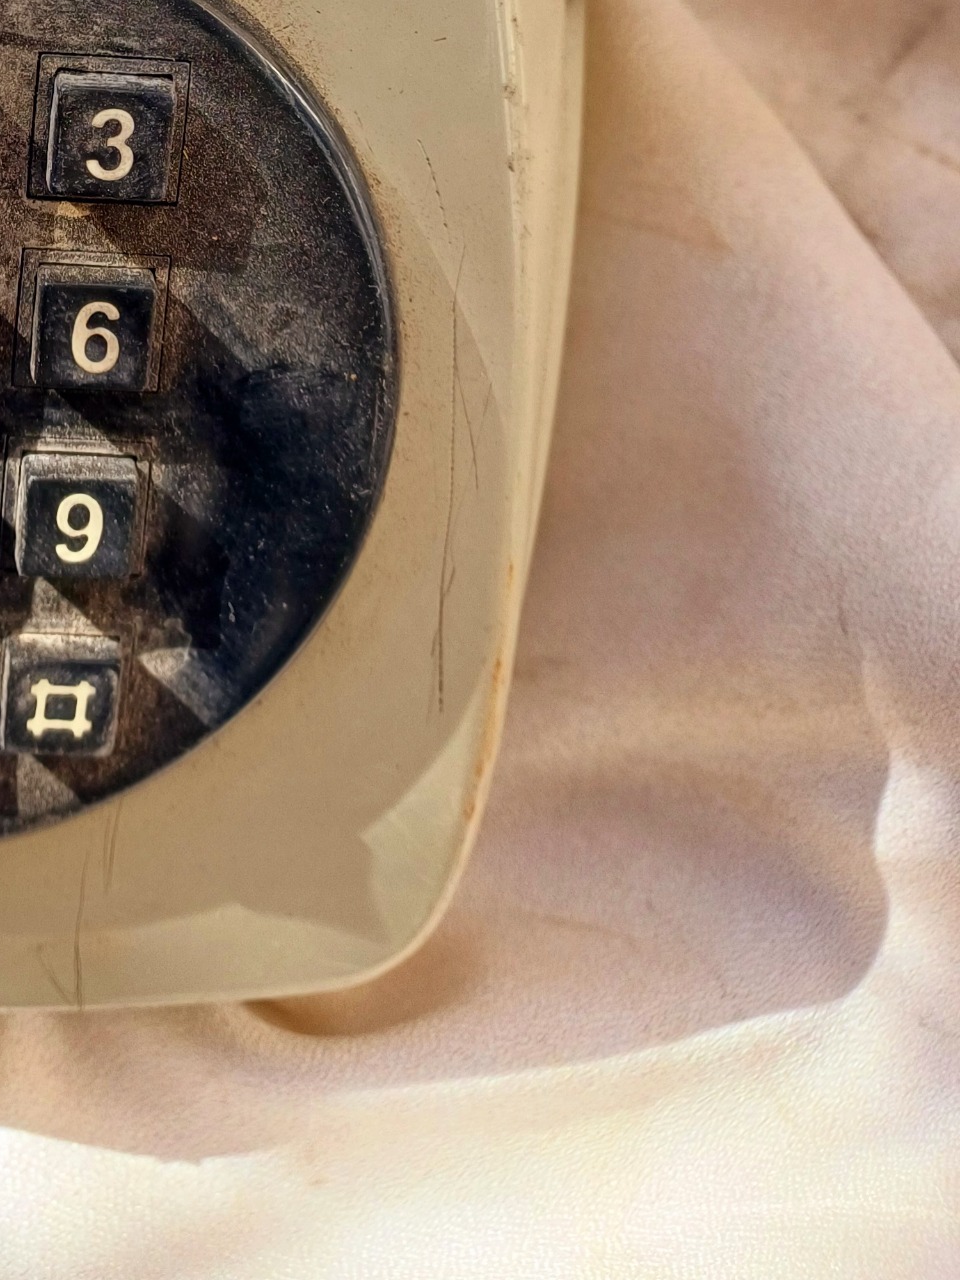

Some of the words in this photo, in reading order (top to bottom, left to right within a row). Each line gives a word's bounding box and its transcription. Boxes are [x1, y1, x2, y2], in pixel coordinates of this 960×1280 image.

[86, 108, 135, 182] 3
[71, 301, 120, 374] 6
[55, 493, 103, 564] 9
